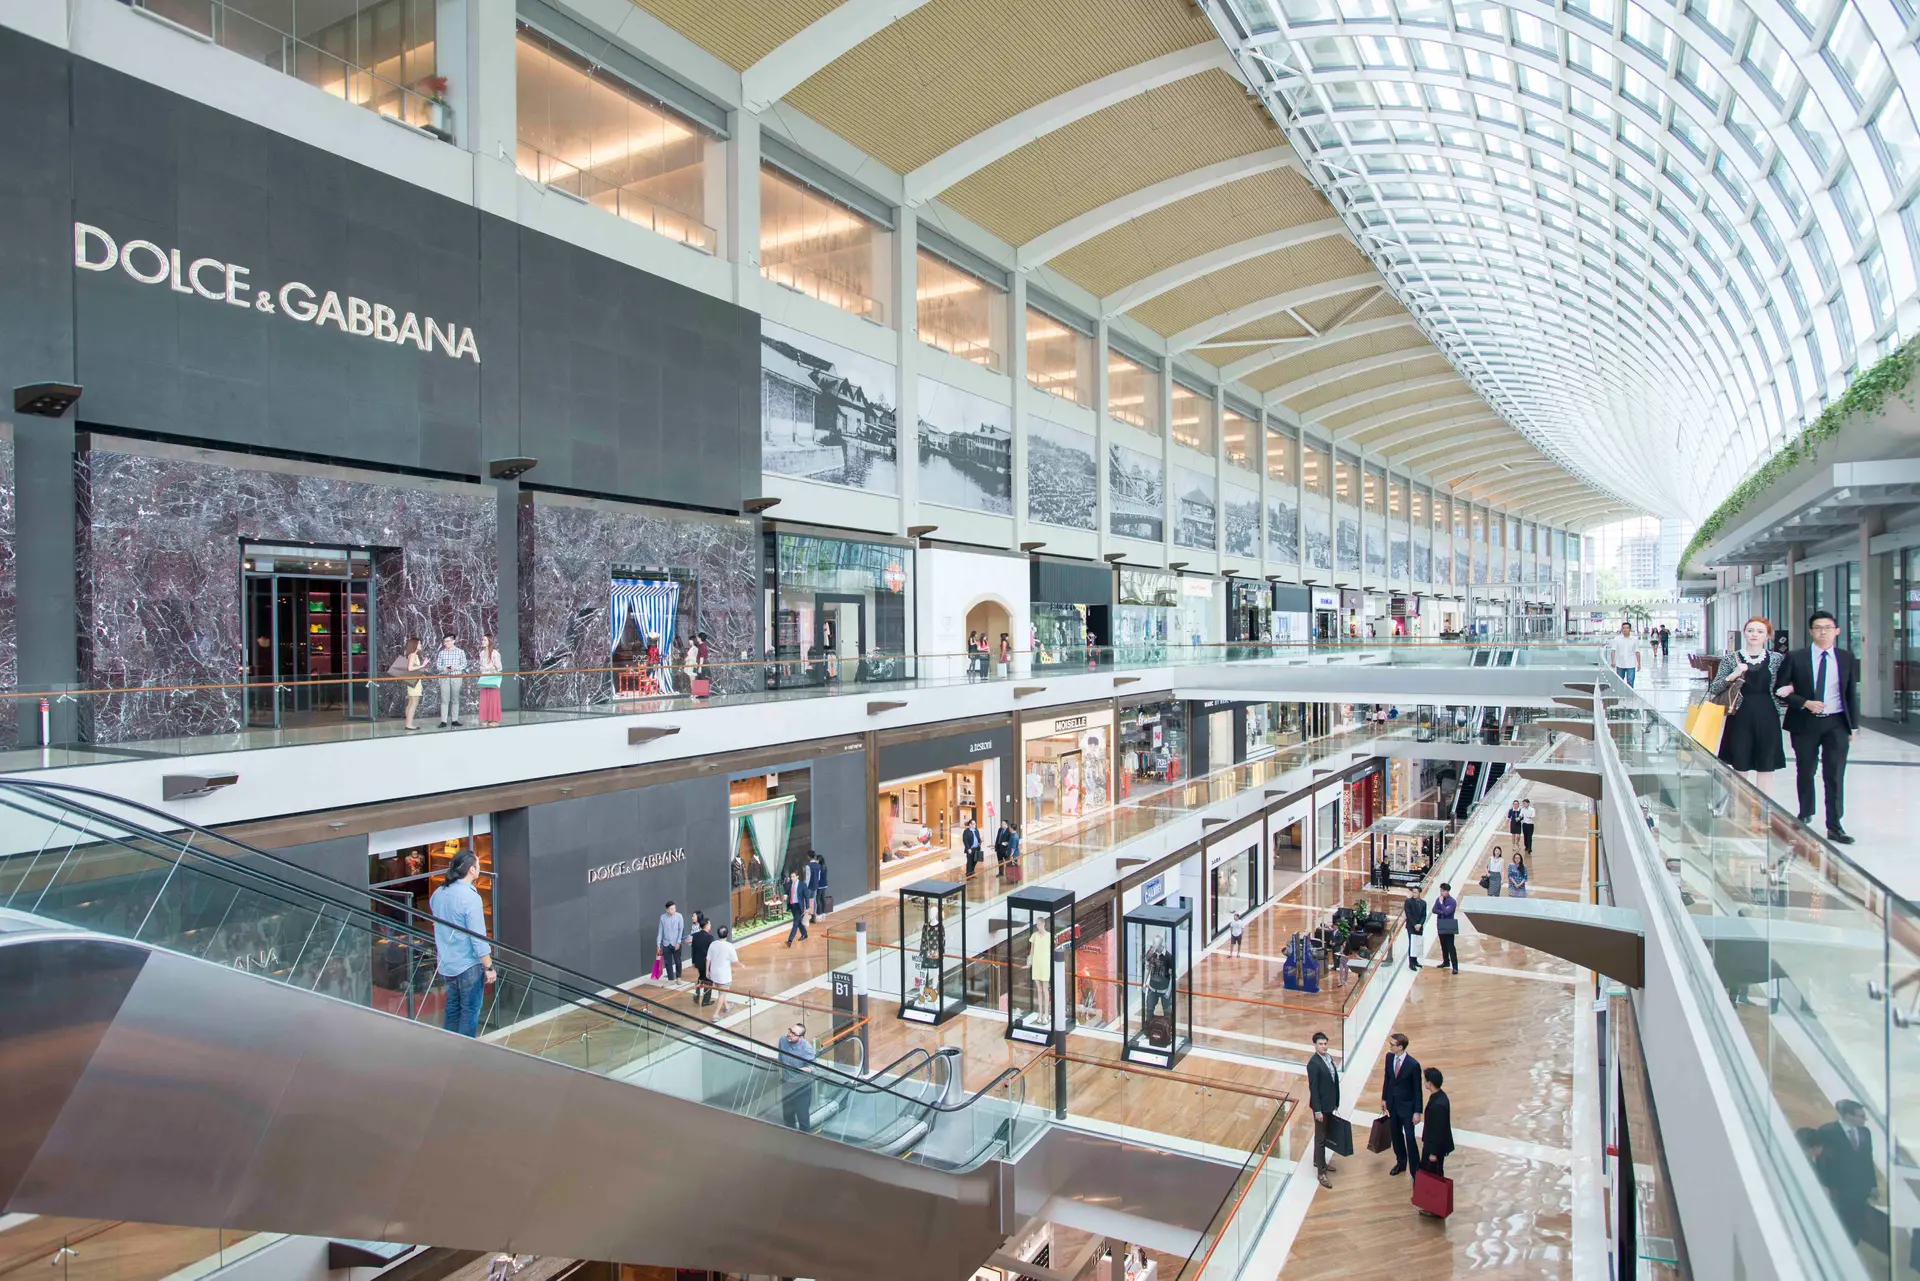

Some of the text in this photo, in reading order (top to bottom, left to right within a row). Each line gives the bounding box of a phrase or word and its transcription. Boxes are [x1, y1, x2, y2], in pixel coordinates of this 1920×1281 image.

[75, 222, 480, 363] DOLCE & GABBANA
[1056, 717, 1086, 731] MOISELLE
[970, 739, 993, 753] a.testoni
[588, 861, 626, 883] DOLCE
[632, 847, 686, 872] GABBANA
[232, 947, 280, 972] ANA
[833, 974, 851, 982] LEVEL
[836, 982, 848, 996] B1
